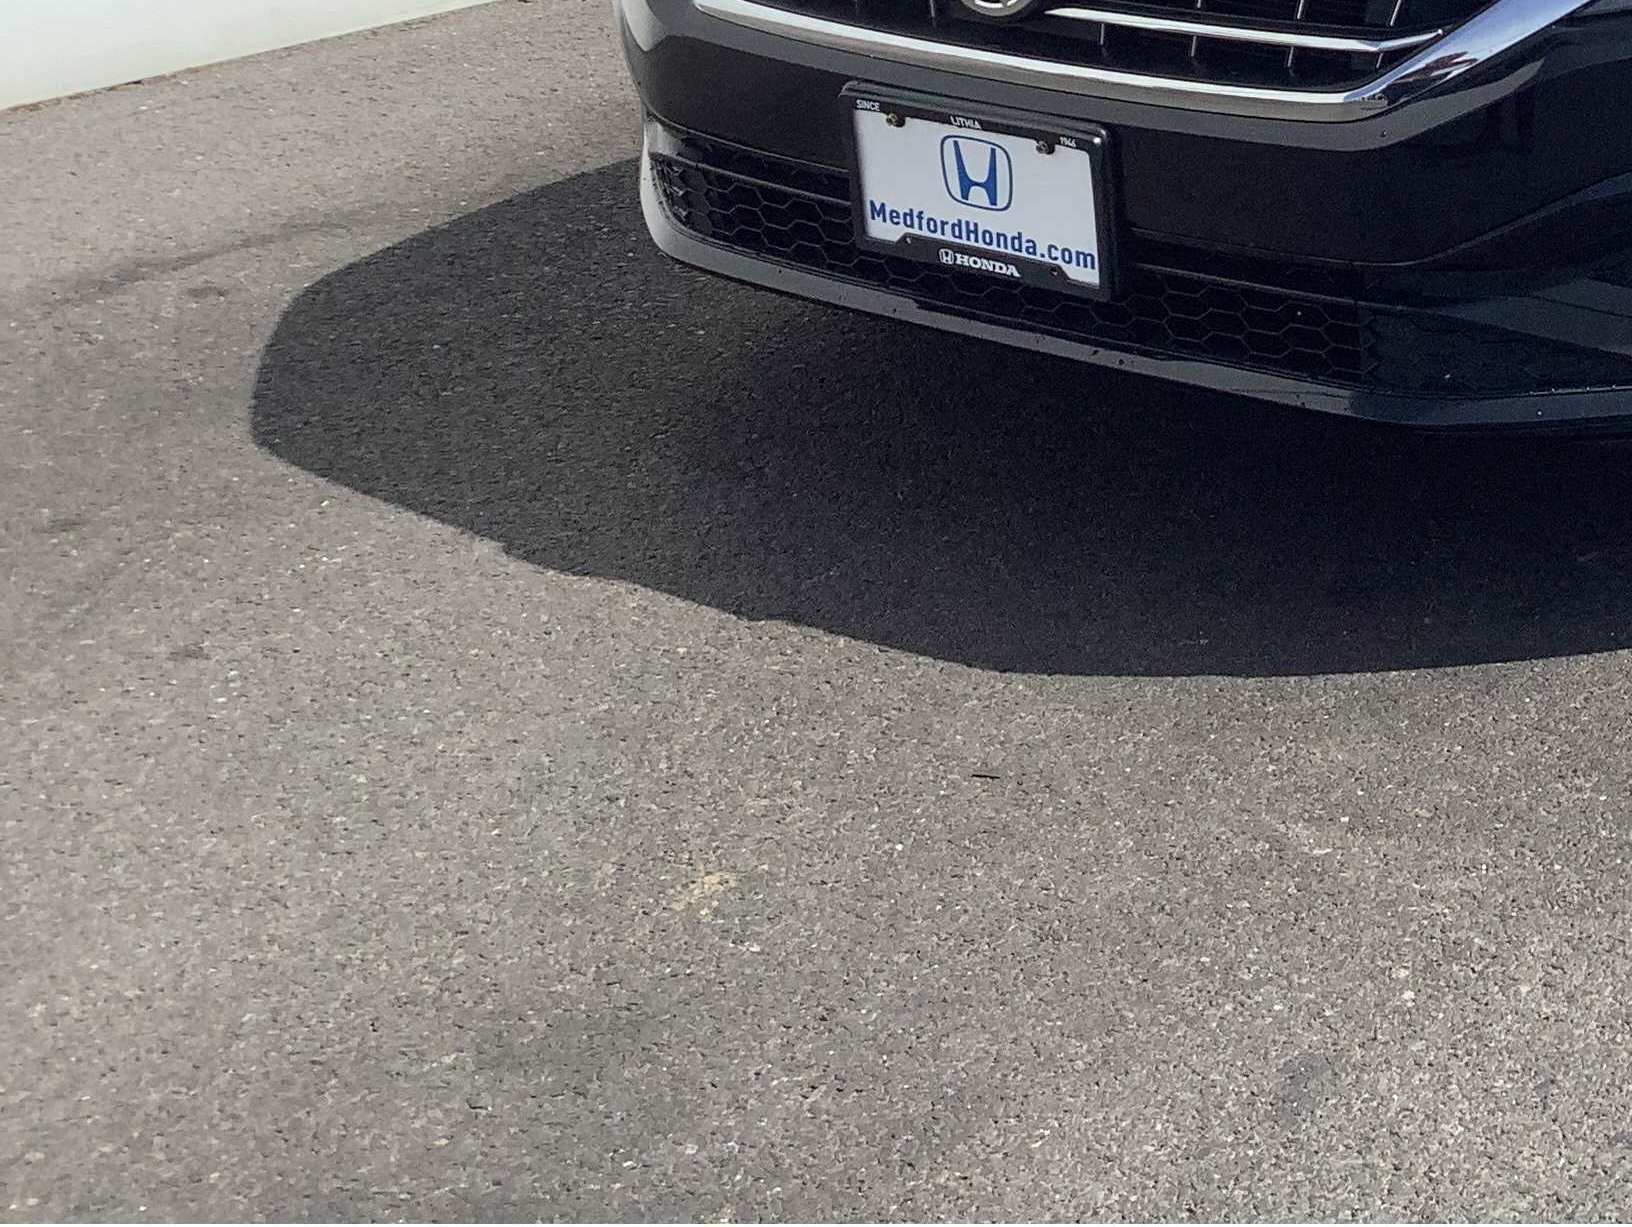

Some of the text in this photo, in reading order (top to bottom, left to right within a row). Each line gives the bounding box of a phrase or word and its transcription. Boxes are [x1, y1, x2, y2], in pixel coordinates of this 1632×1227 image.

[856, 99, 880, 111] SINCE
[950, 115, 981, 129] LITHIA
[869, 199, 1095, 270] MedfordHonda.com
[955, 253, 1022, 278] HONDA
